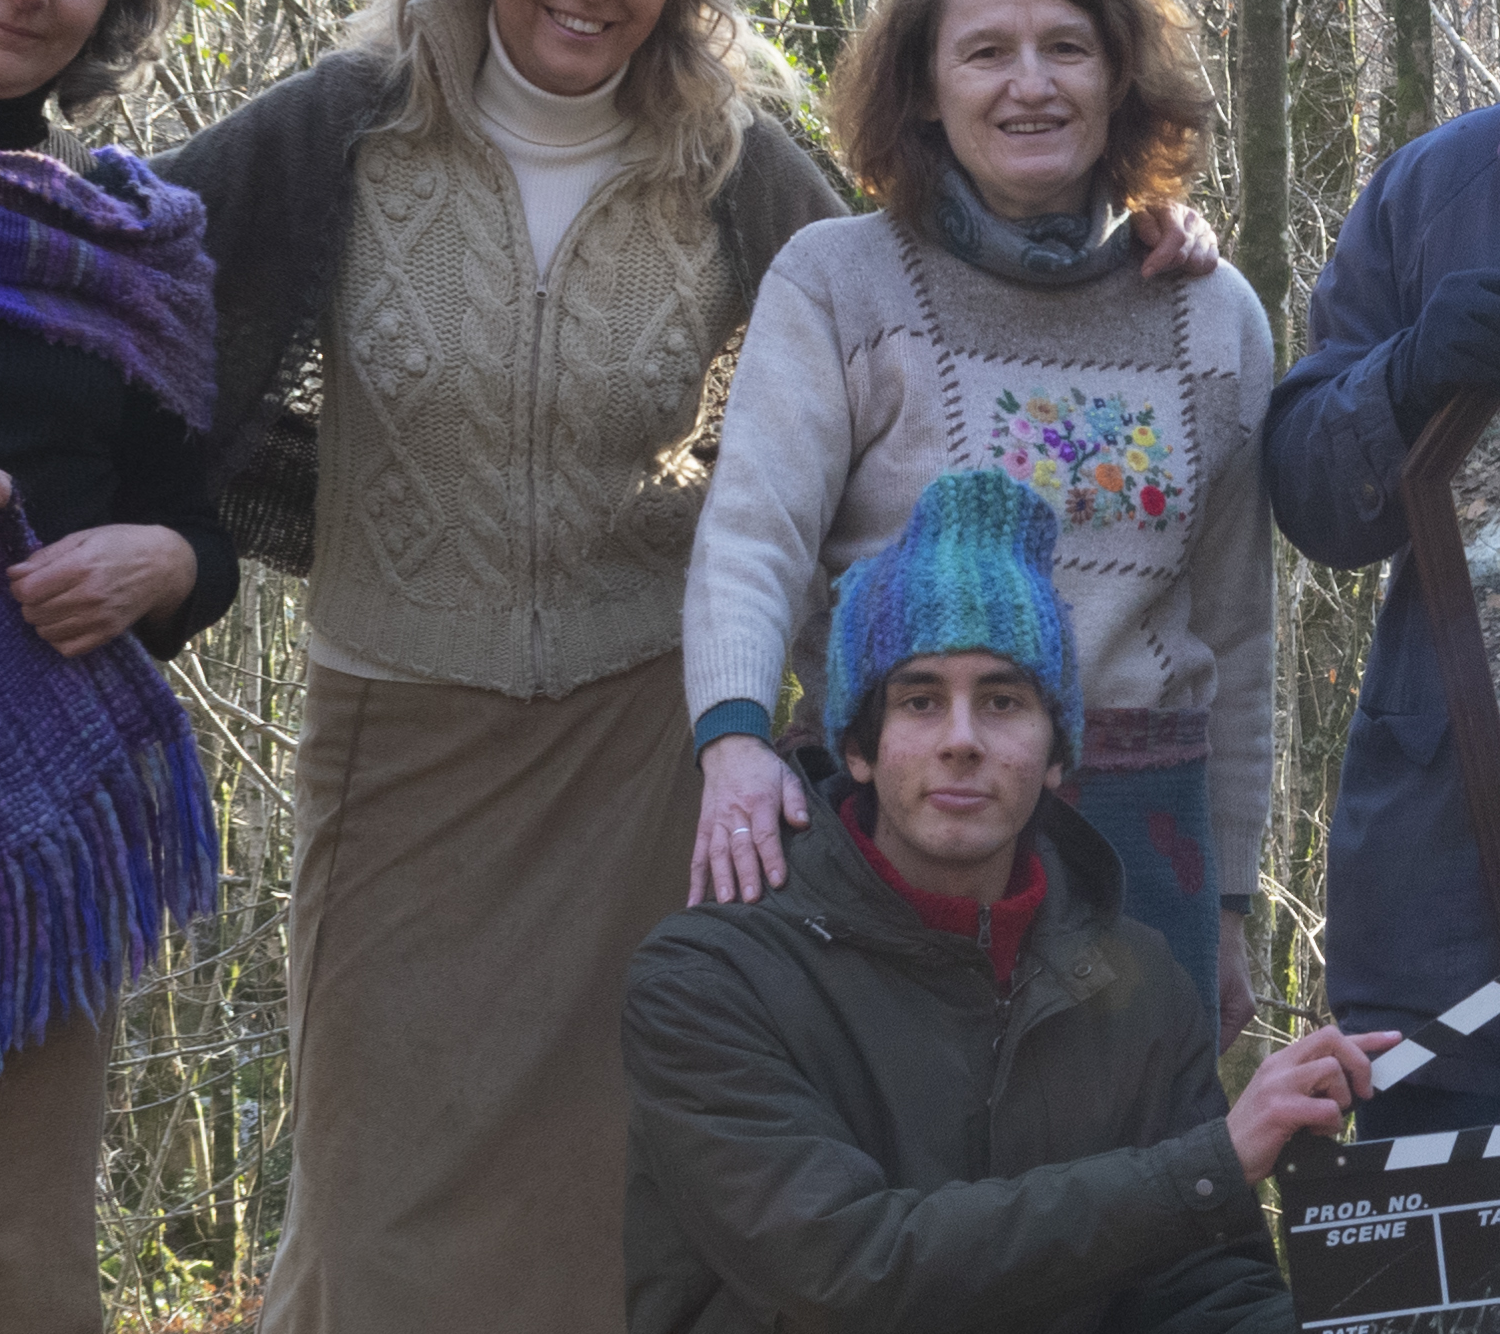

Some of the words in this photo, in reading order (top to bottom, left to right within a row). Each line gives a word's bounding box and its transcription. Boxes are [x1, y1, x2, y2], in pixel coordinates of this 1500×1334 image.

[1304, 1200, 1377, 1224] PROD.
[1388, 1193, 1429, 1213] NO.
[1326, 1221, 1407, 1247] SCENE
